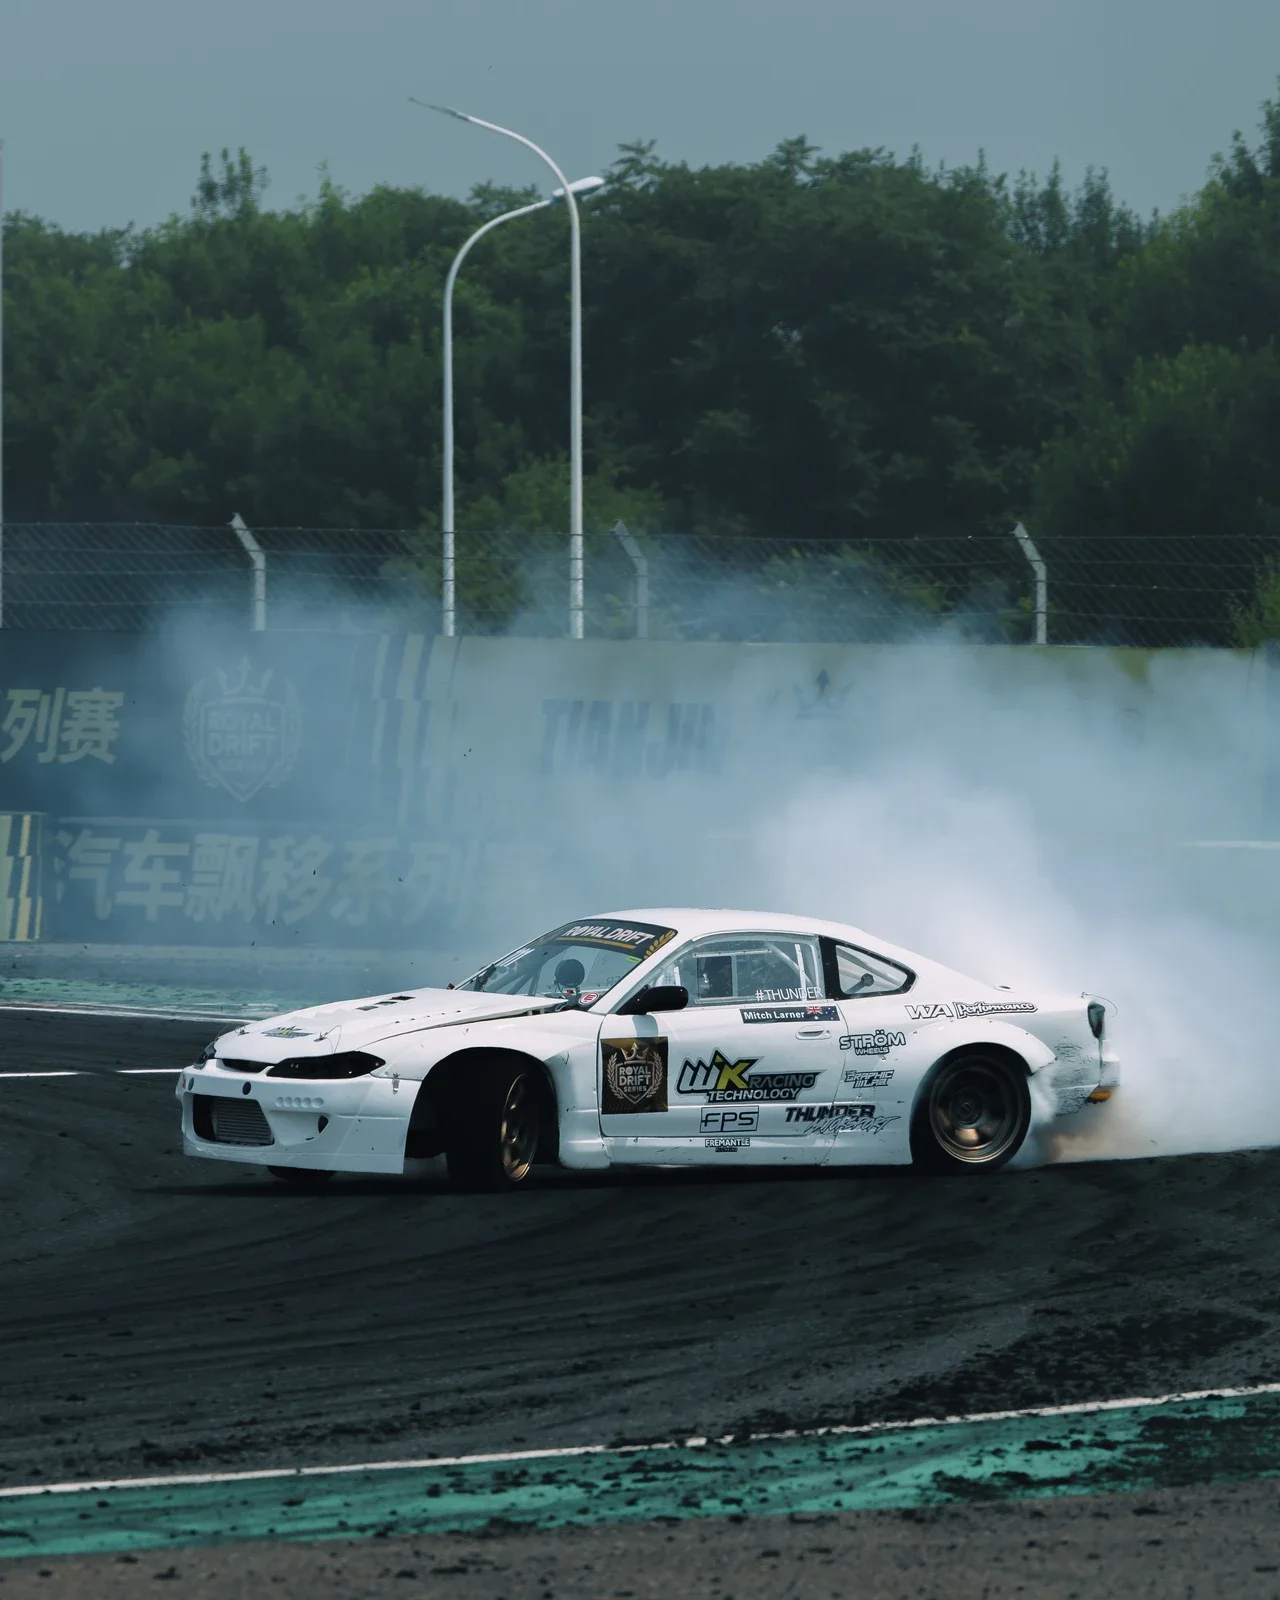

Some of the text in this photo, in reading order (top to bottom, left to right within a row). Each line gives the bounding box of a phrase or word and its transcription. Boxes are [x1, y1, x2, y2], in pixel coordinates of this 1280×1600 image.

[207, 711, 277, 731] ROYAL
[207, 732, 278, 756] DRIFT
[564, 926, 655, 945] ROYAL DRIFT
[755, 987, 823, 1001] #THUNDER
[743, 1010, 805, 1020] Mitch Larner
[904, 1001, 1037, 1020] WA Performance
[839, 1028, 907, 1050] STRÖM
[855, 1046, 890, 1056] WHEELS
[619, 1066, 651, 1076] ROYAL
[619, 1075, 651, 1086] DRIFT
[749, 1074, 814, 1089] RACING
[623, 1085, 647, 1093] SERIES
[708, 1088, 800, 1101] TECHNOLOGY
[785, 1104, 876, 1122] THUNDER
[701, 1112, 758, 1132] FPS
[705, 1138, 750, 1147] FREMANTLE
